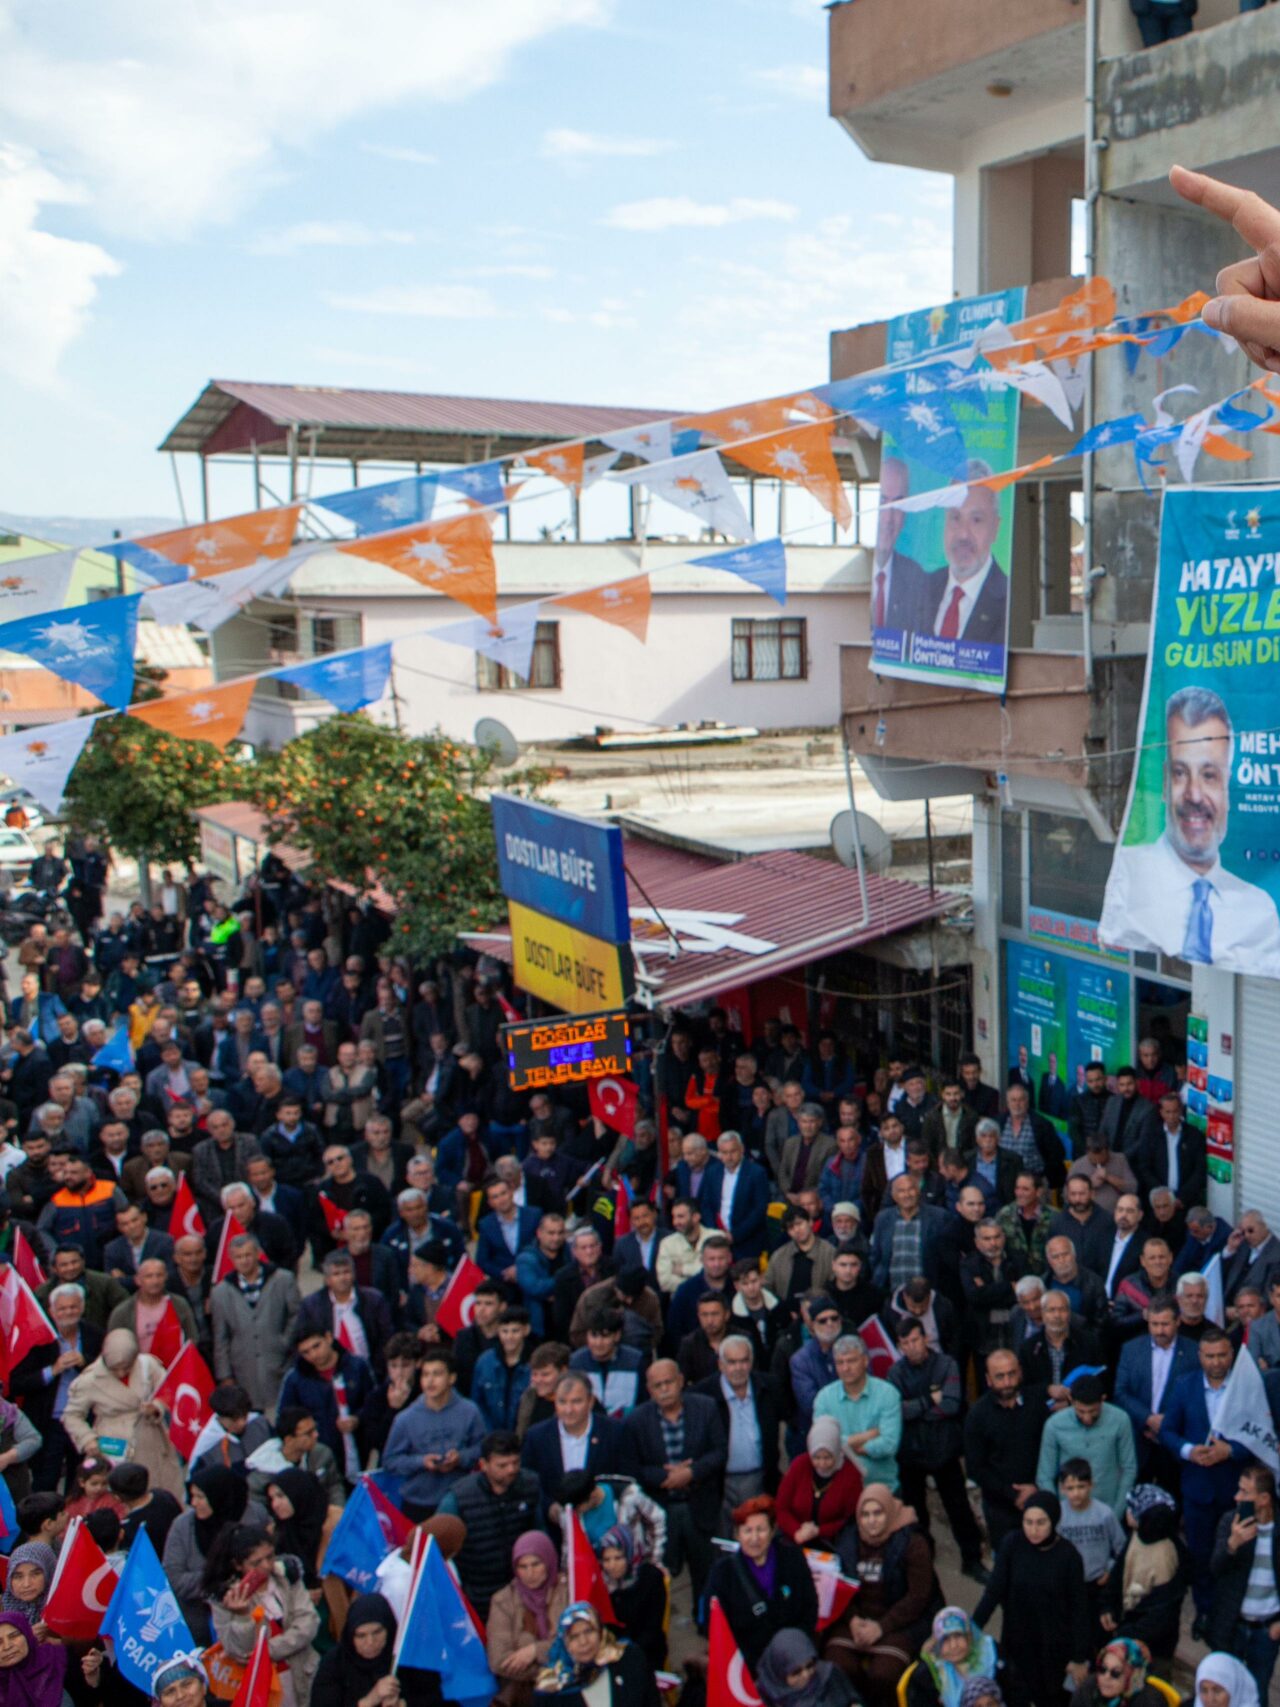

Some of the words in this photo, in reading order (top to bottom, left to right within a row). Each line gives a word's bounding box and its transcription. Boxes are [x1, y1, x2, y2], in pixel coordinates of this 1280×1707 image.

[959, 647, 990, 661] HATAY
[505, 832, 560, 879] DOSTLAR
[560, 848, 597, 893] BÜFE
[524, 936, 574, 984] DOSTLAR
[573, 957, 607, 1001] BÜFE
[531, 1021, 607, 1050] DOSTLAR
